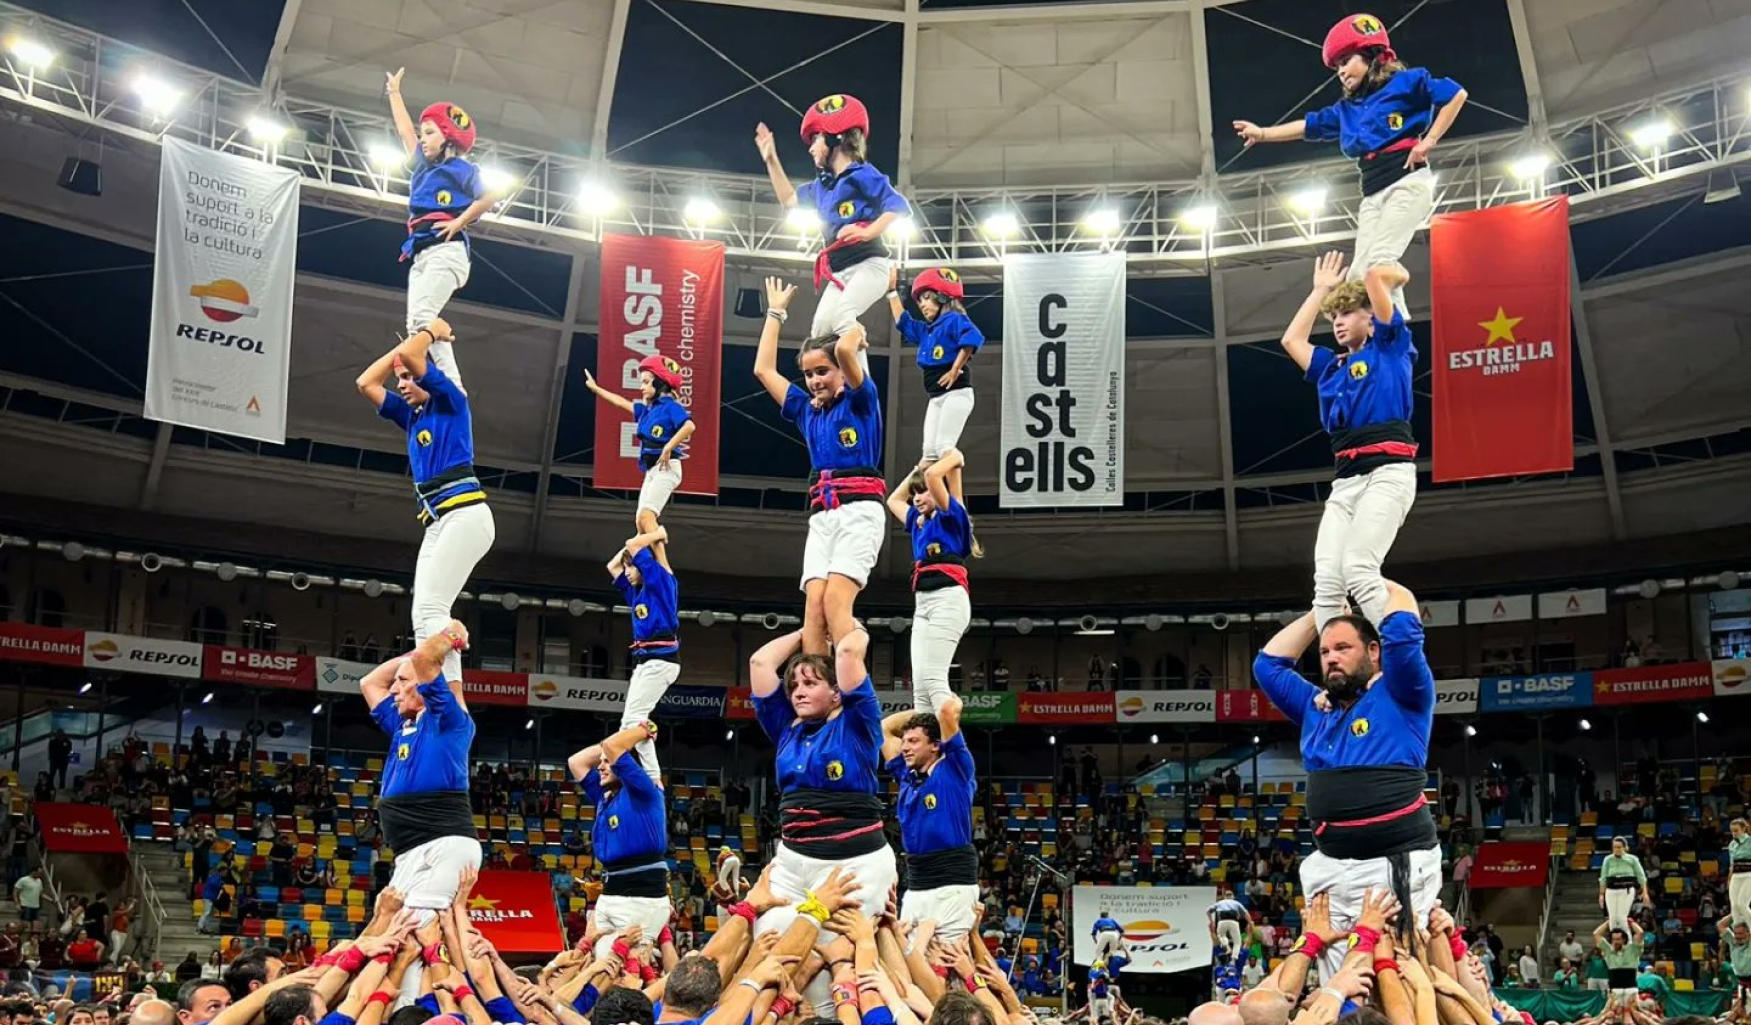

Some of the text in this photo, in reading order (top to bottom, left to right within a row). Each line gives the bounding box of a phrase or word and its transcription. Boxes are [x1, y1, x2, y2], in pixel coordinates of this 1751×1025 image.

[188, 171, 248, 198] Donem
[186, 191, 273, 225] suport a la
[185, 209, 248, 237] tradició
[184, 227, 262, 260] la cultura
[677, 268, 701, 361] chemistry
[176, 323, 265, 354] REPSOL
[1449, 341, 1554, 369] ESTRELLA
[1483, 363, 1521, 376] DAMM
[1106, 371, 1120, 410] Catalunya
[1106, 411, 1116, 421] de
[42, 642, 81, 655] DAMM
[129, 649, 200, 667] REPSOL
[248, 653, 298, 670] BASF
[493, 684, 526, 695] DAMM
[1524, 676, 1575, 692] BASF
[1613, 676, 1710, 692] ESTRELLA DAMM
[1033, 704, 1113, 714] ESTRELLA DAMM
[1153, 702, 1214, 712] REPSOL
[1148, 893, 1189, 901] suport
[468, 909, 534, 918] RELLA
